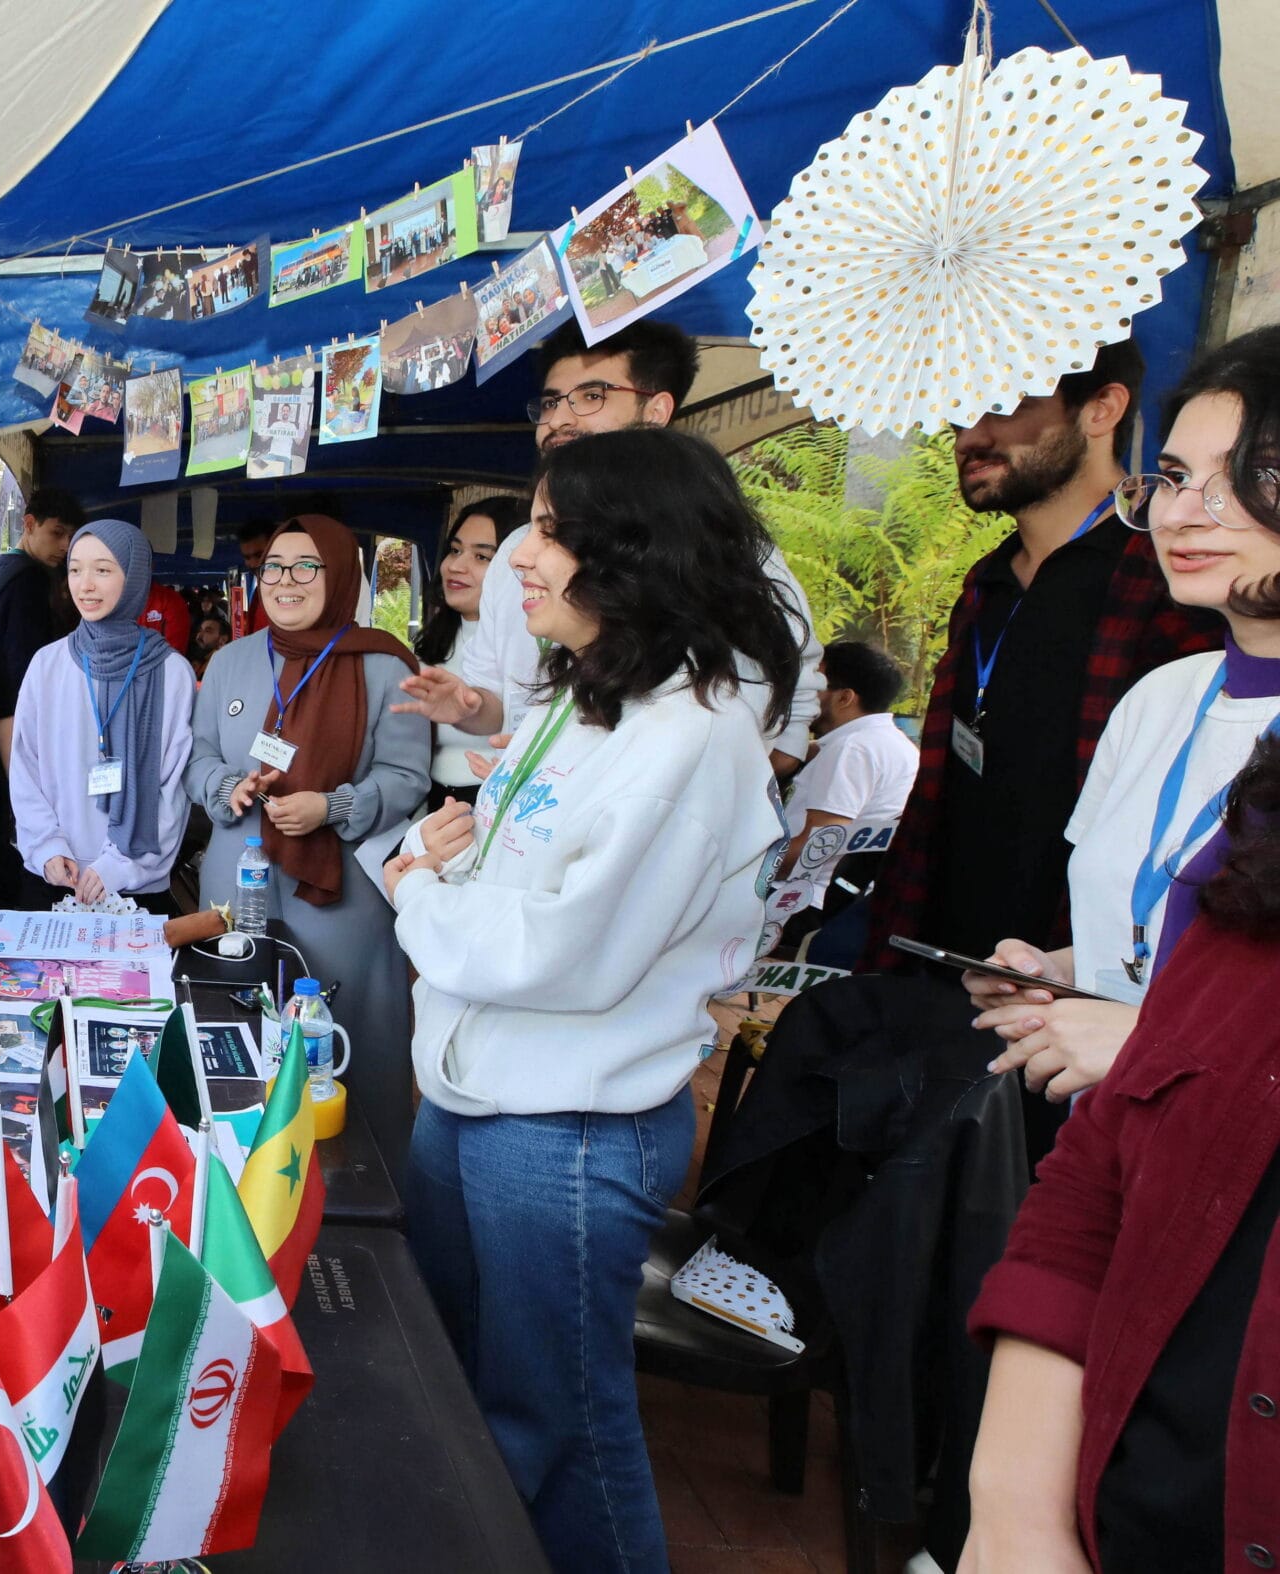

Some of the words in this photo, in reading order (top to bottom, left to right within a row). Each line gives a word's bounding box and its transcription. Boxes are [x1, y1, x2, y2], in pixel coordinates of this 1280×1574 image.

[755, 966, 841, 992] HAT
[307, 1254, 337, 1313] BELEDİYESİ
[325, 1257, 356, 1311] ŞAHİNBEY
